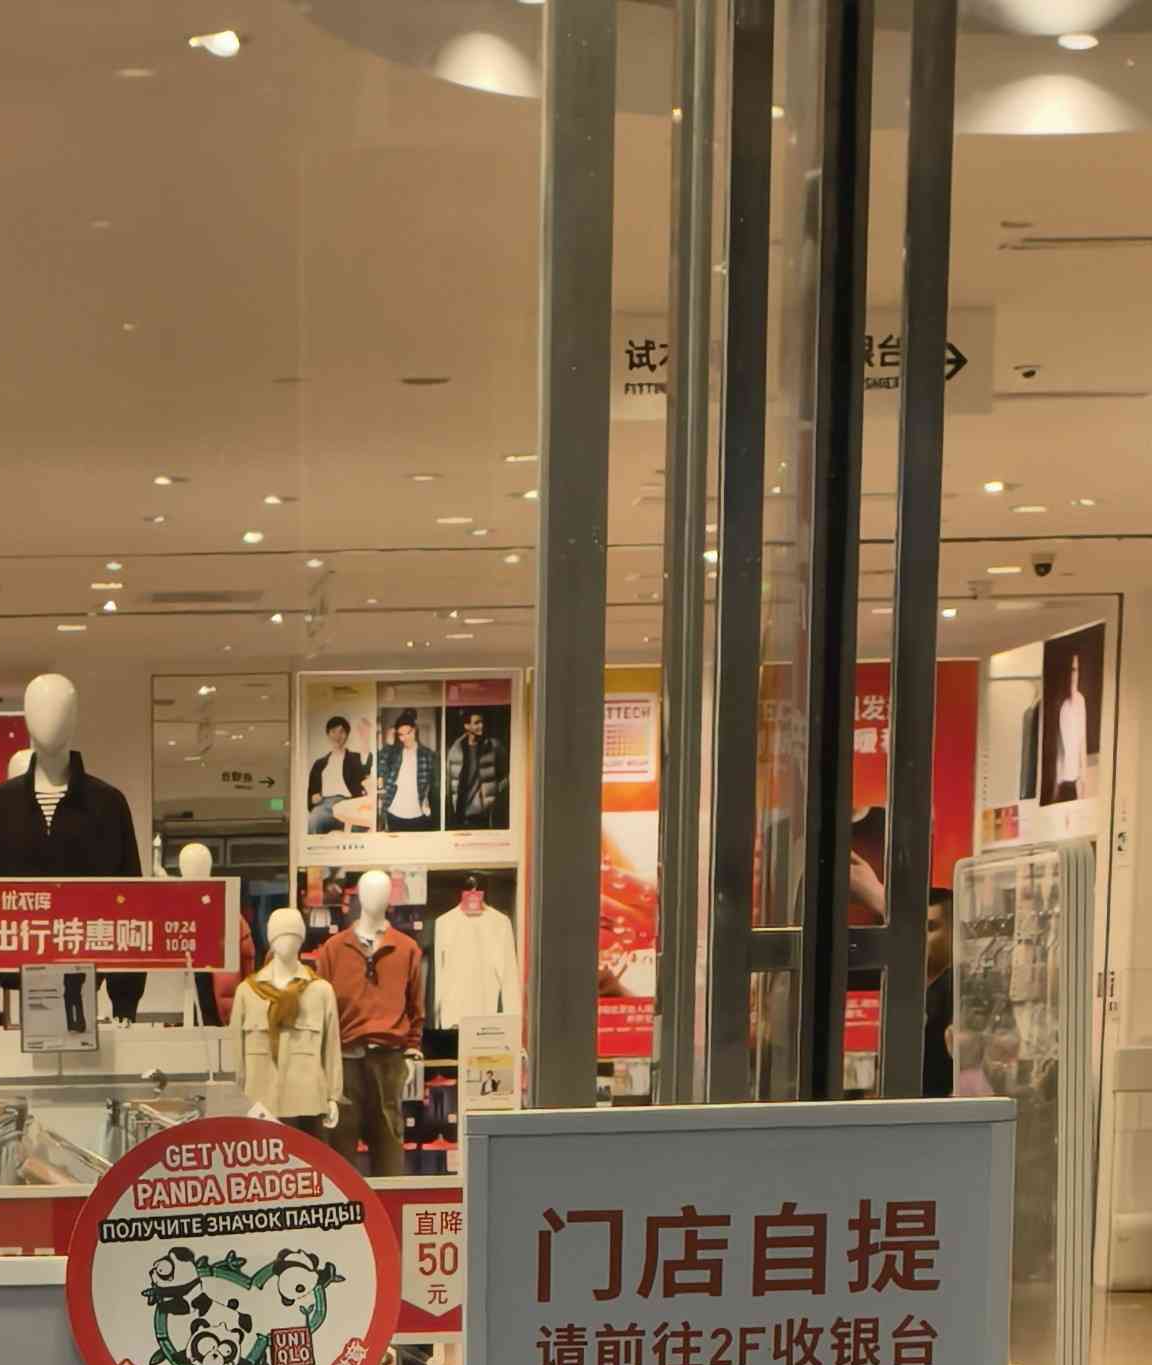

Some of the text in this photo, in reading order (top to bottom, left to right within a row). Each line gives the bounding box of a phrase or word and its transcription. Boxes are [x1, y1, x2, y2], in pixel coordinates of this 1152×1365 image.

[165, 1138, 285, 1170] GET YOUR
[136, 1171, 323, 1209] PANDA BADGE!
[102, 1204, 362, 1241] ПОЛУЧИТЕ ЗНАЧОК ПАНДЫ!
[413, 1211, 463, 1237] 直降
[417, 1242, 458, 1276] 50
[537, 1199, 940, 1303] 门店自提
[427, 1286, 448, 1305] 元
[276, 1332, 307, 1347] UNI
[278, 1348, 311, 1365] QLO
